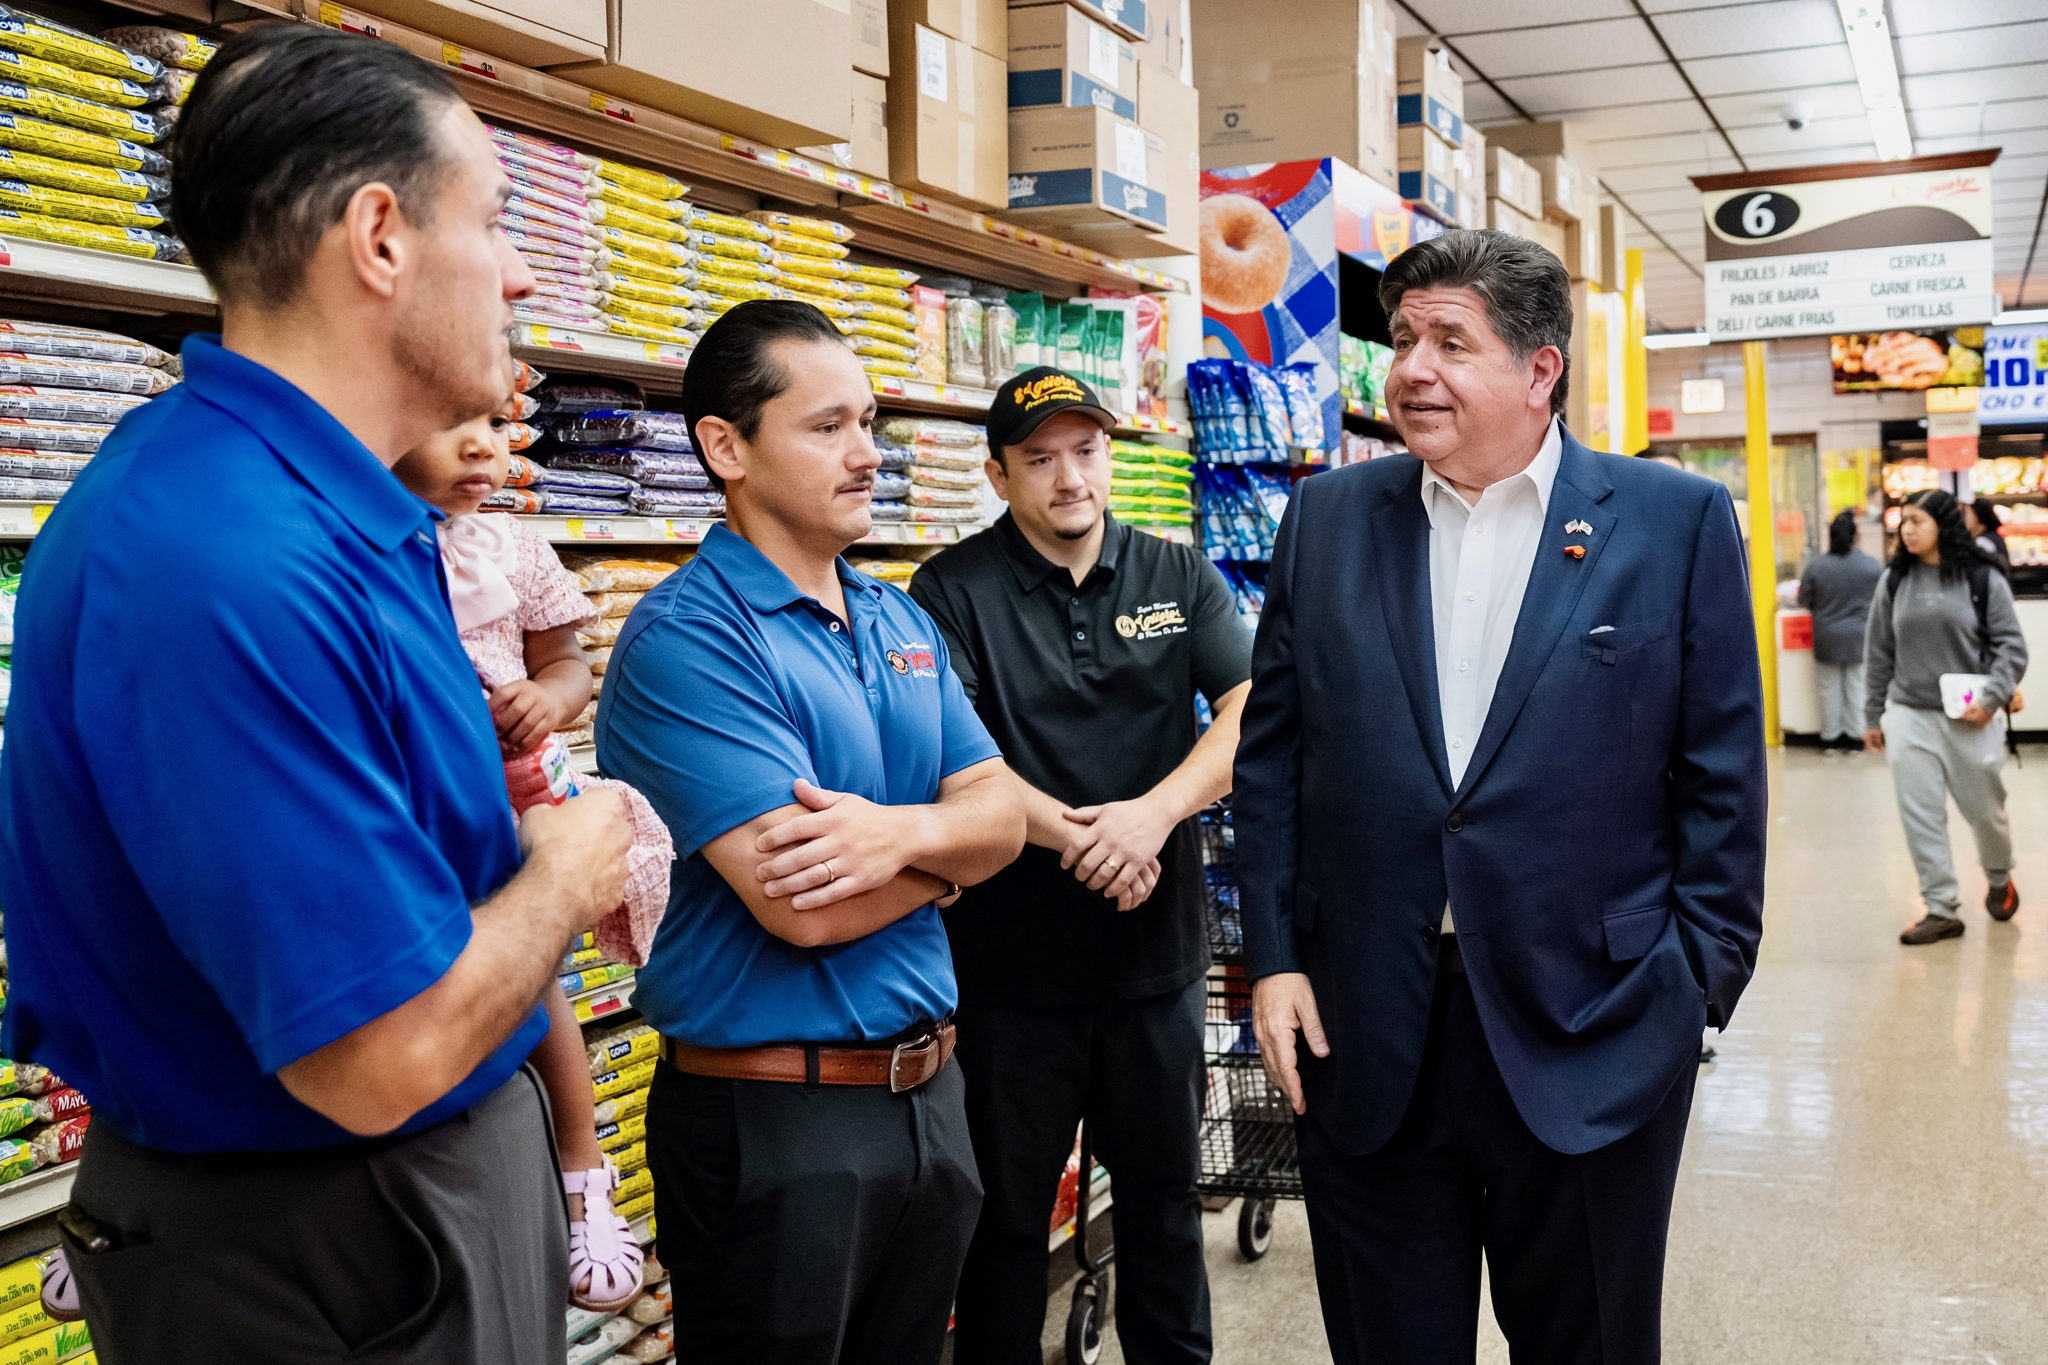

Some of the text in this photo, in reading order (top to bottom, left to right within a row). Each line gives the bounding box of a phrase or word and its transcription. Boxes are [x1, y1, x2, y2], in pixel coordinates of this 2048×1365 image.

[1743, 193, 1776, 236] 6
[1890, 252, 1946, 269] CERVEZA
[1721, 262, 1776, 283] FRIJOLES
[1788, 261, 1829, 277] ARROZ
[1730, 287, 1820, 307] PAN DE BARRA
[1871, 277, 1966, 298] CARNE FRESCA
[1887, 302, 1953, 320] TORTILLAS
[1717, 317, 1744, 333] DELI
[1755, 313, 1797, 330] CARNE
[1800, 310, 1835, 327] FRIAS
[610, 1044, 631, 1058] GOYA
[22, 1283, 36, 1294] 907g
